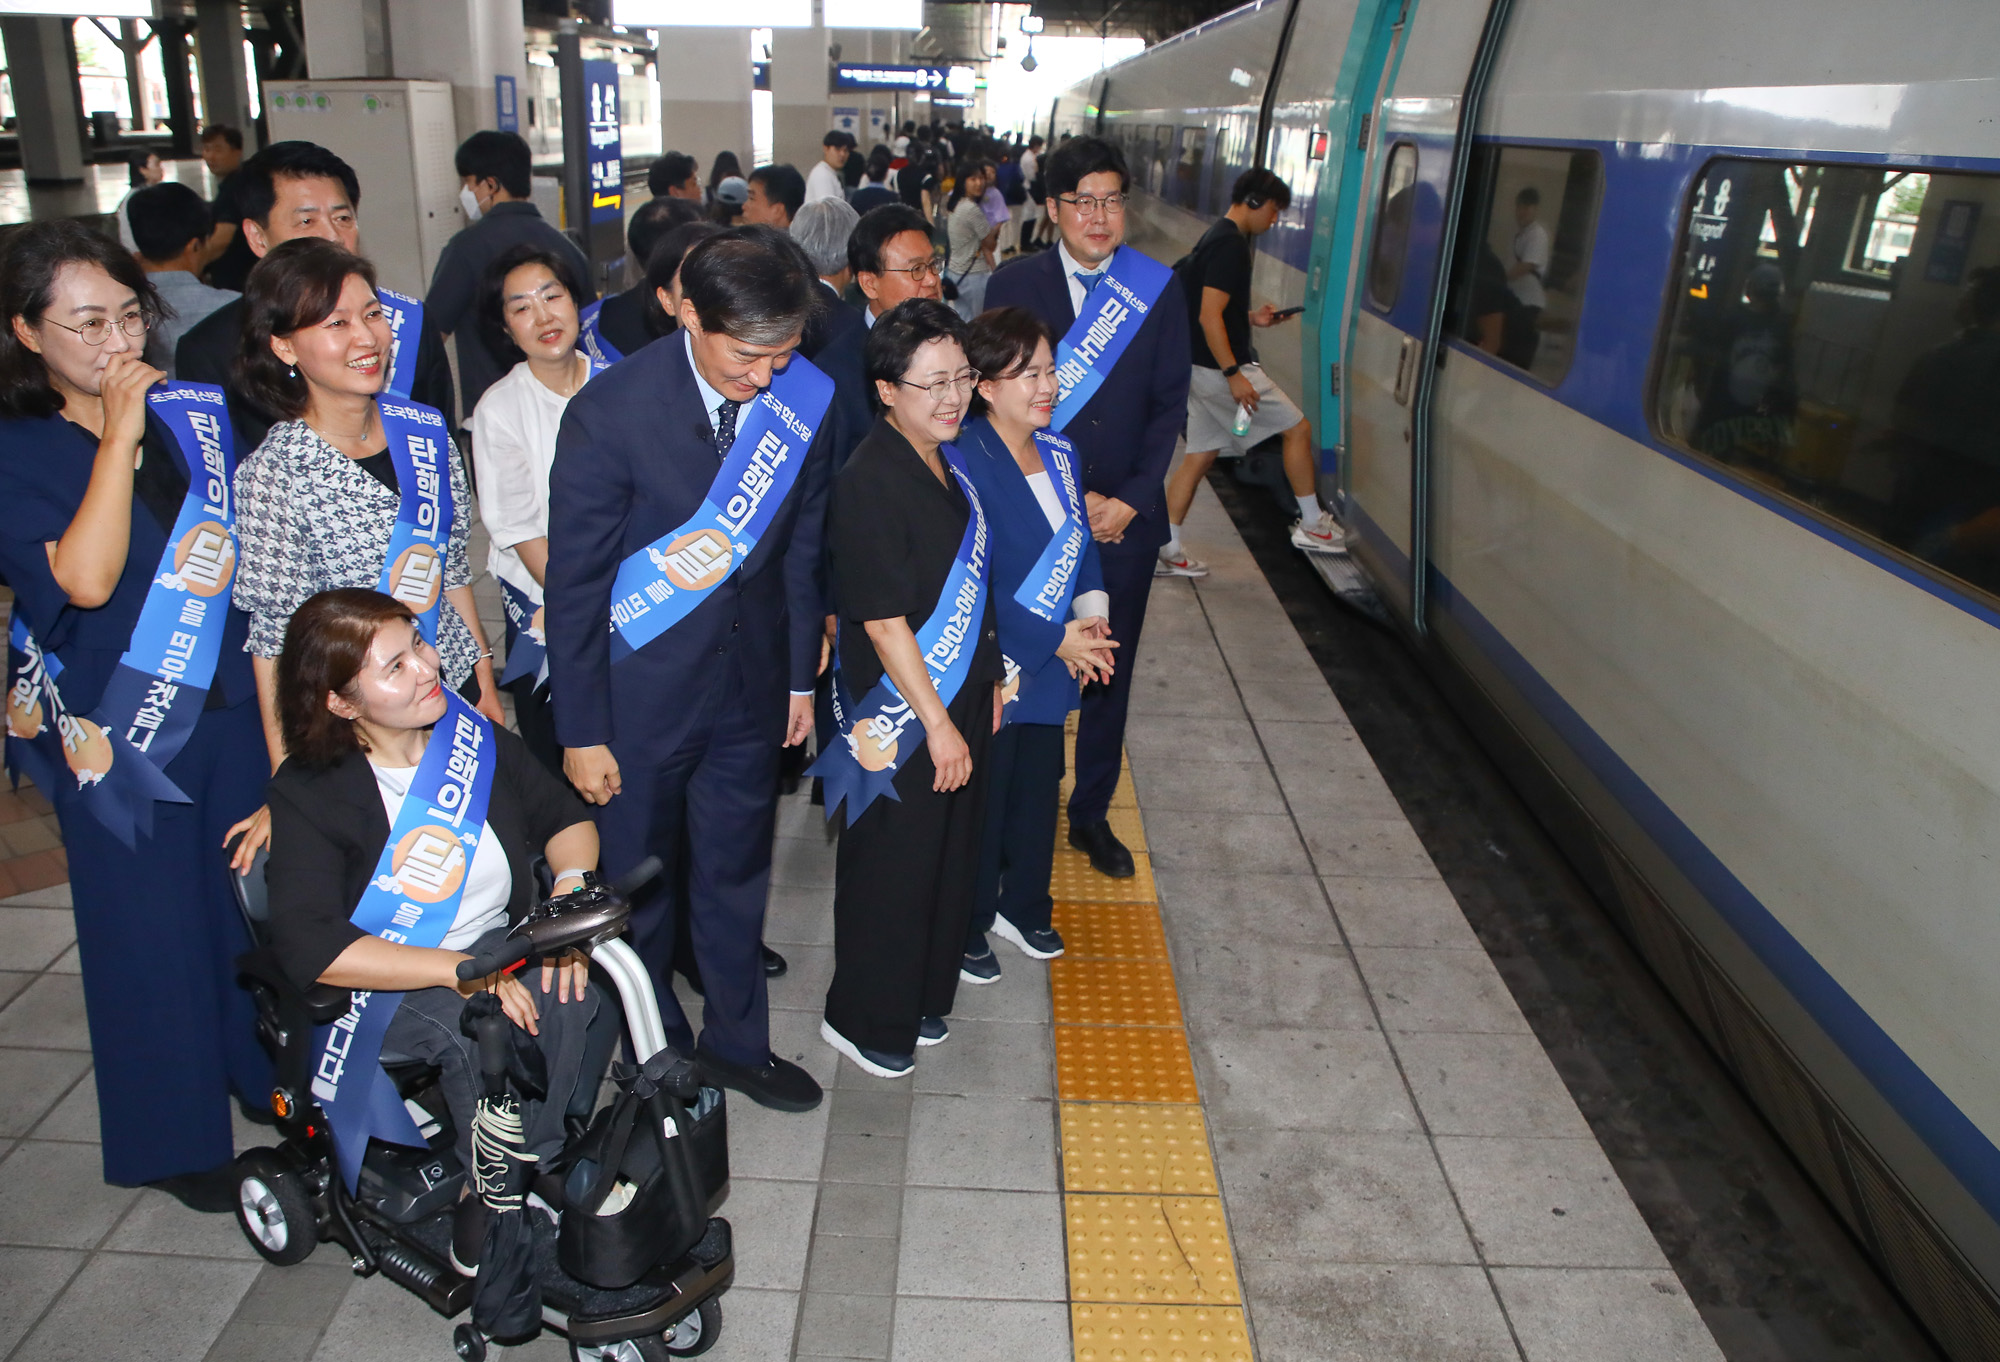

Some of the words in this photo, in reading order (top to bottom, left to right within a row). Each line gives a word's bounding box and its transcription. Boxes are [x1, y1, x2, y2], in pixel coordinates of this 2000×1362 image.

[916, 69, 928, 87] 8
[1073, 296, 1130, 367] 마음도
[1104, 275, 1149, 314] 조국혁신당
[148, 389, 224, 405] 조국혁신당
[382, 403, 443, 427] 조국혁신당
[761, 391, 812, 442] 조국혁신당
[186, 410, 229, 521] 탄핵의
[407, 434, 441, 542] 탄핵의
[714, 430, 789, 536] 탄핵의
[1051, 450, 1083, 526] 마음도
[1036, 526, 1083, 609] 풍성한
[923, 577, 979, 673] 풍성한
[125, 630, 197, 753] 띄우겠습니
[426, 712, 484, 828] 탄핵의
